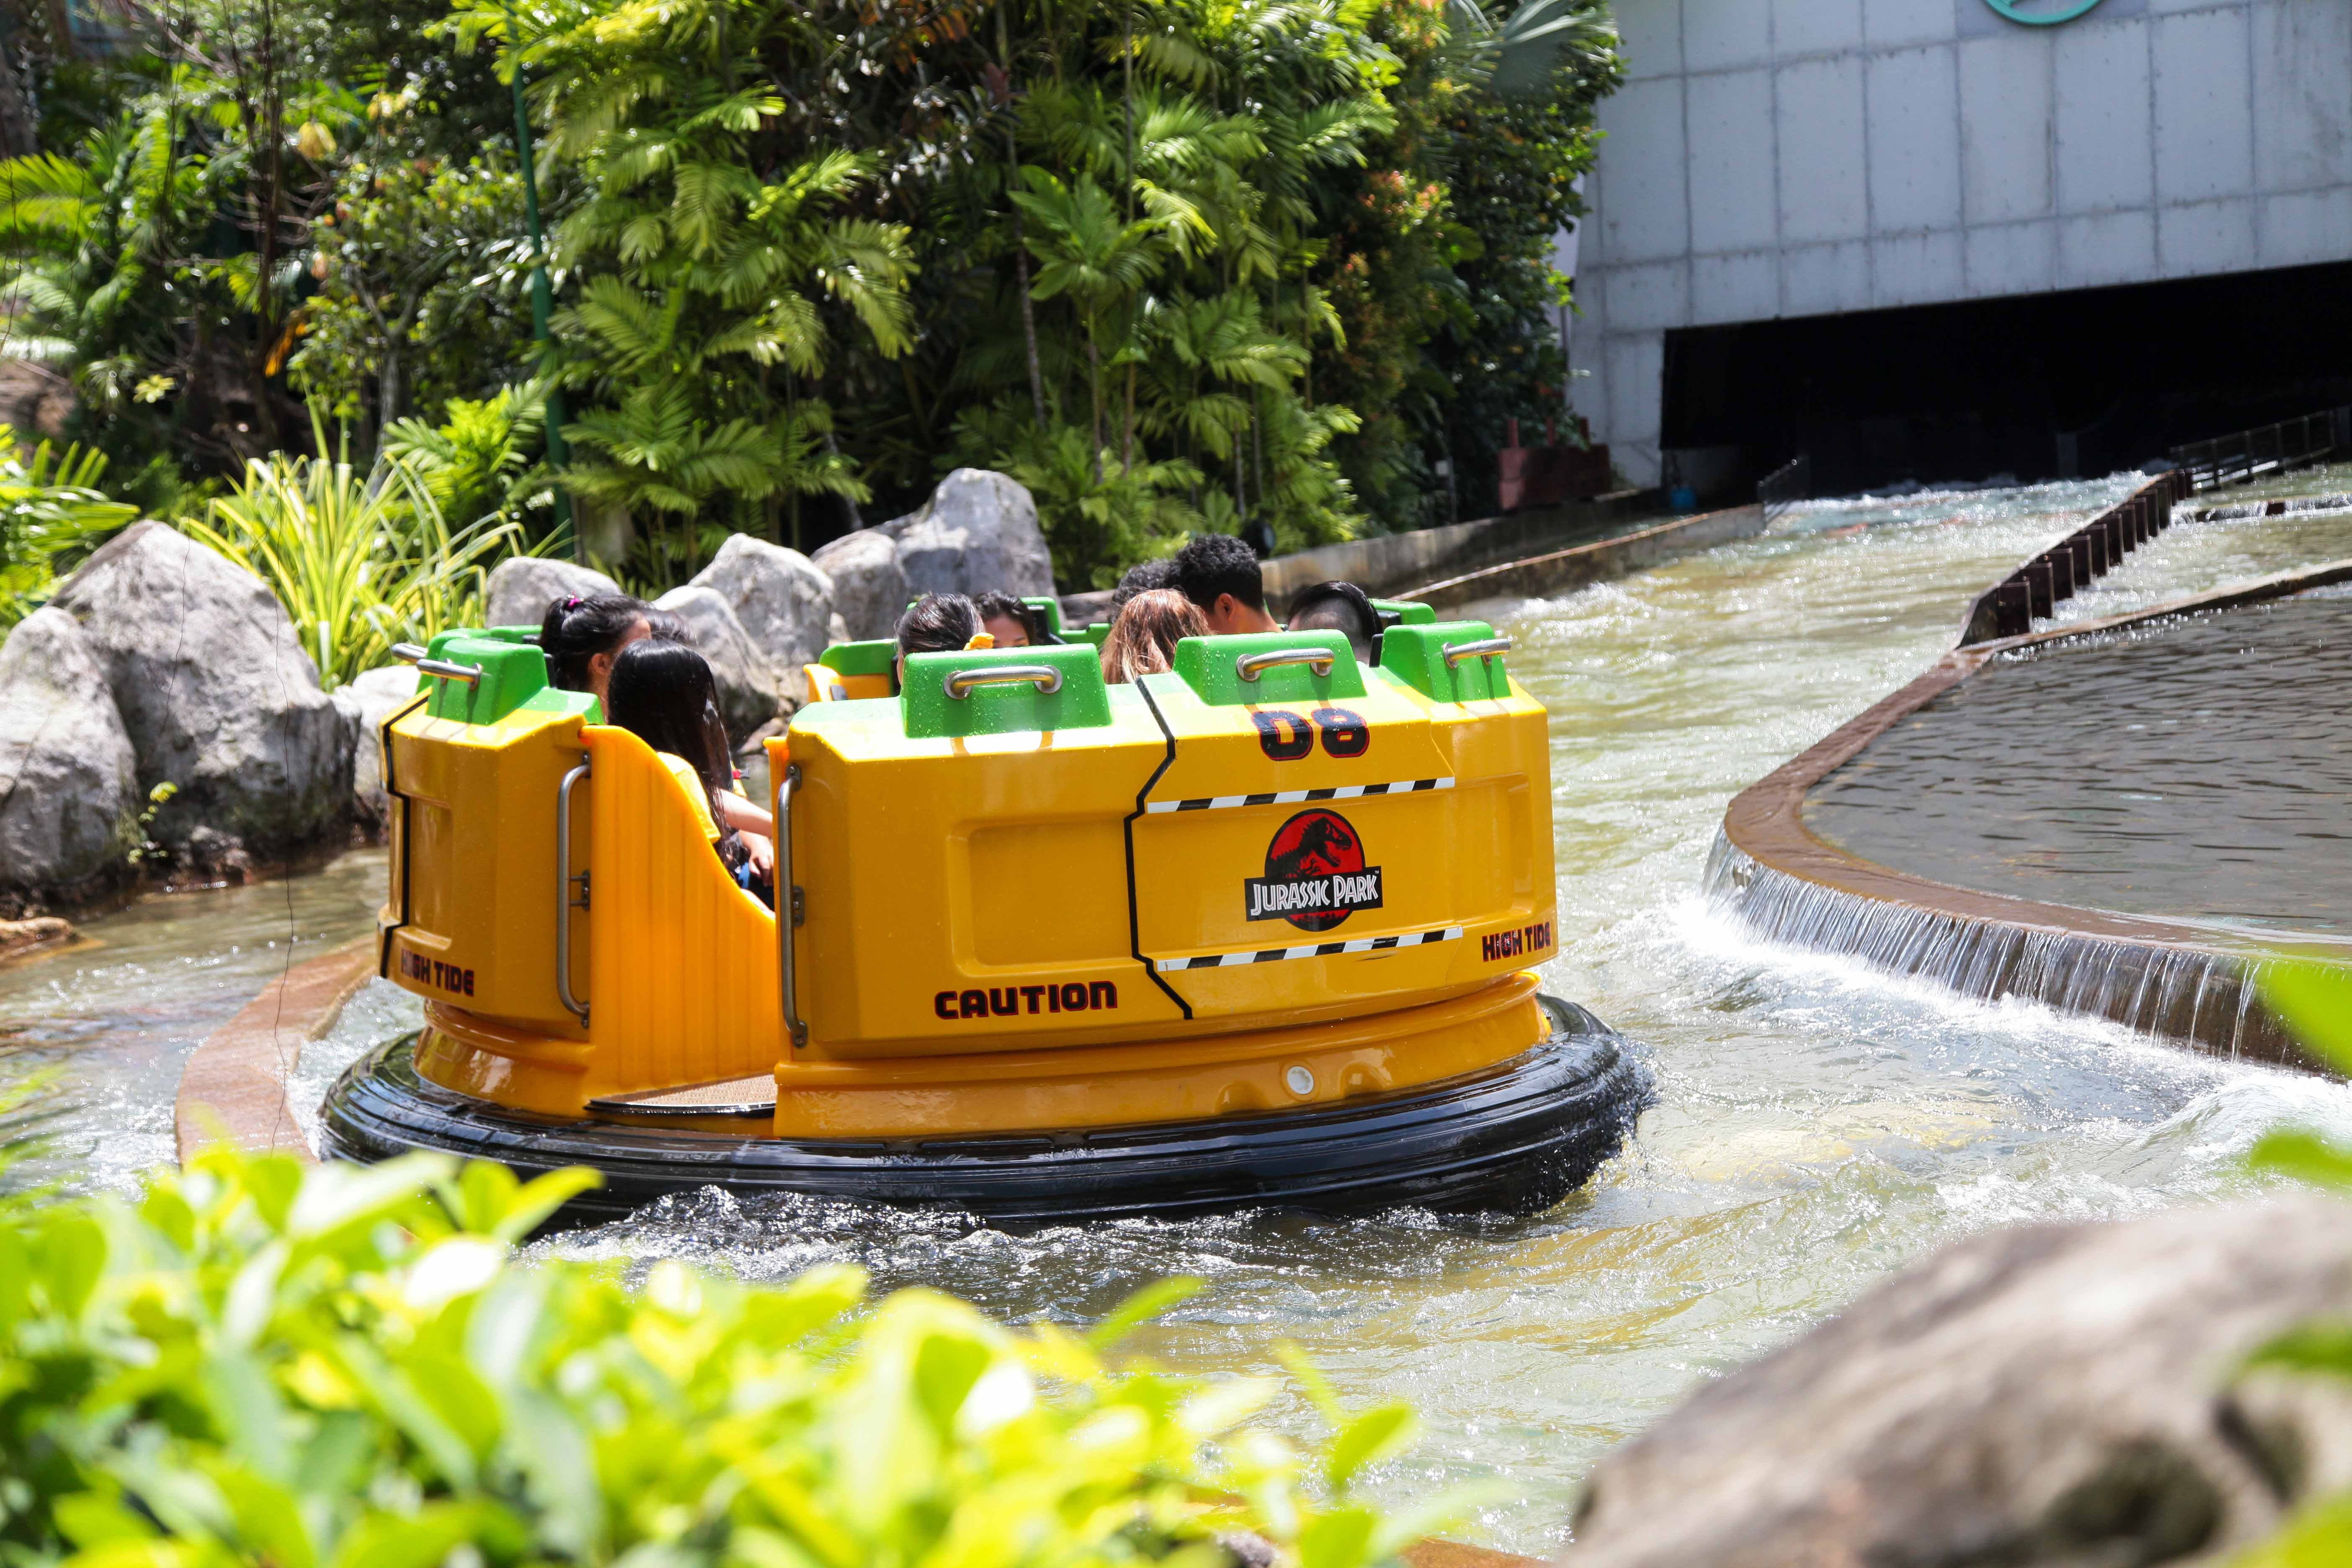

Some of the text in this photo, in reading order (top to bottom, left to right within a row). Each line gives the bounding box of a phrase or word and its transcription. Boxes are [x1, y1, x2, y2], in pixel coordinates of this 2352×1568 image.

[1251, 708, 1370, 761] 08
[1250, 879, 1331, 916] JURASSIC
[1333, 874, 1379, 908] PARK
[1482, 927, 1523, 962] HIGH
[433, 961, 474, 997] TIDE
[934, 980, 1118, 1020] CAUTION
